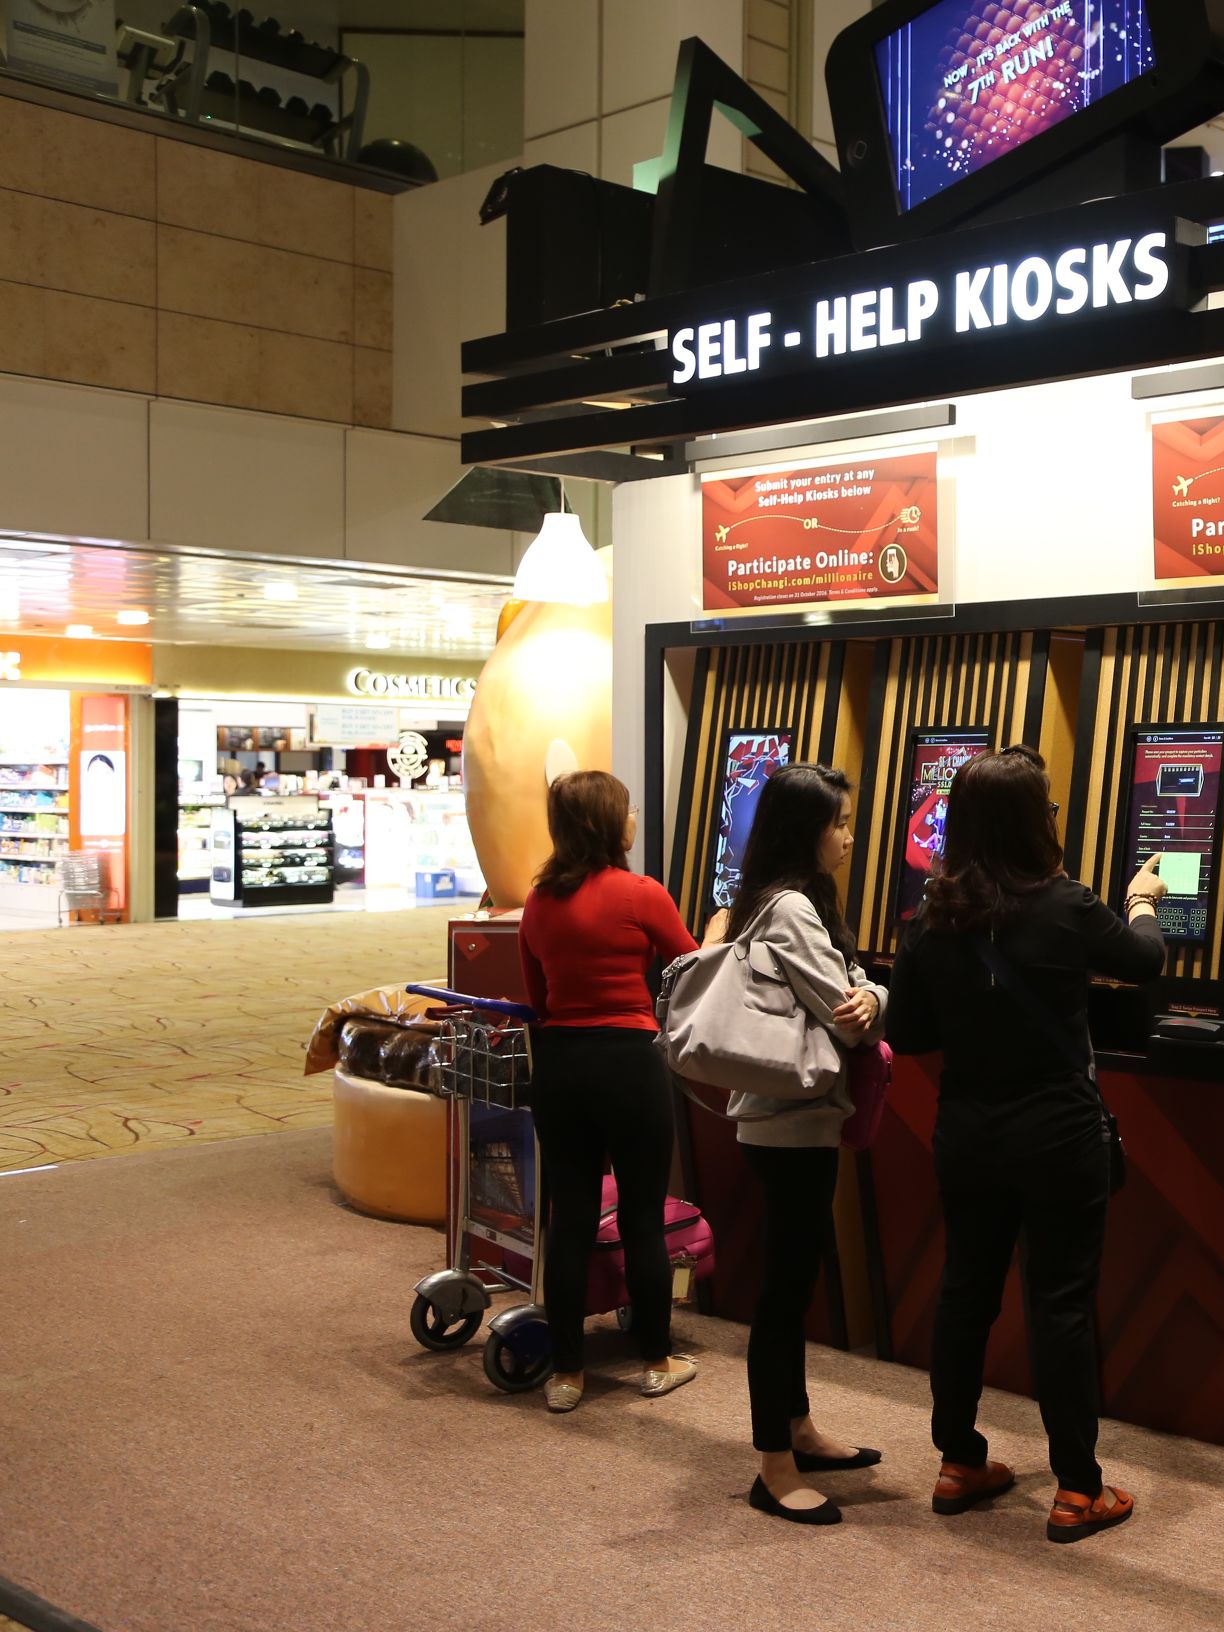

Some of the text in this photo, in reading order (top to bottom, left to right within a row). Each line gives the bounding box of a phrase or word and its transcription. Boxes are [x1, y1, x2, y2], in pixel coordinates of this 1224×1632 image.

[943, 64, 968, 88] NOW
[976, 49, 994, 67] IT'S
[995, 31, 1021, 55] BACK
[1022, 15, 1049, 38] WITH
[1050, 1, 1071, 20] THE
[967, 36, 1054, 104] 7TH RUN!
[671, 311, 772, 385] SELF
[815, 279, 939, 359] HELP
[955, 232, 1170, 333] KIOSKS
[755, 468, 875, 493] Submit your entry at any
[758, 486, 872, 508] Self-Help Kiosks below
[1172, 499, 1197, 507] Catching
[1202, 497, 1221, 505] flight?
[803, 518, 818, 530] OR
[728, 549, 874, 577] Participate Online:
[728, 571, 873, 591] iShopChangi.com/millionaire
